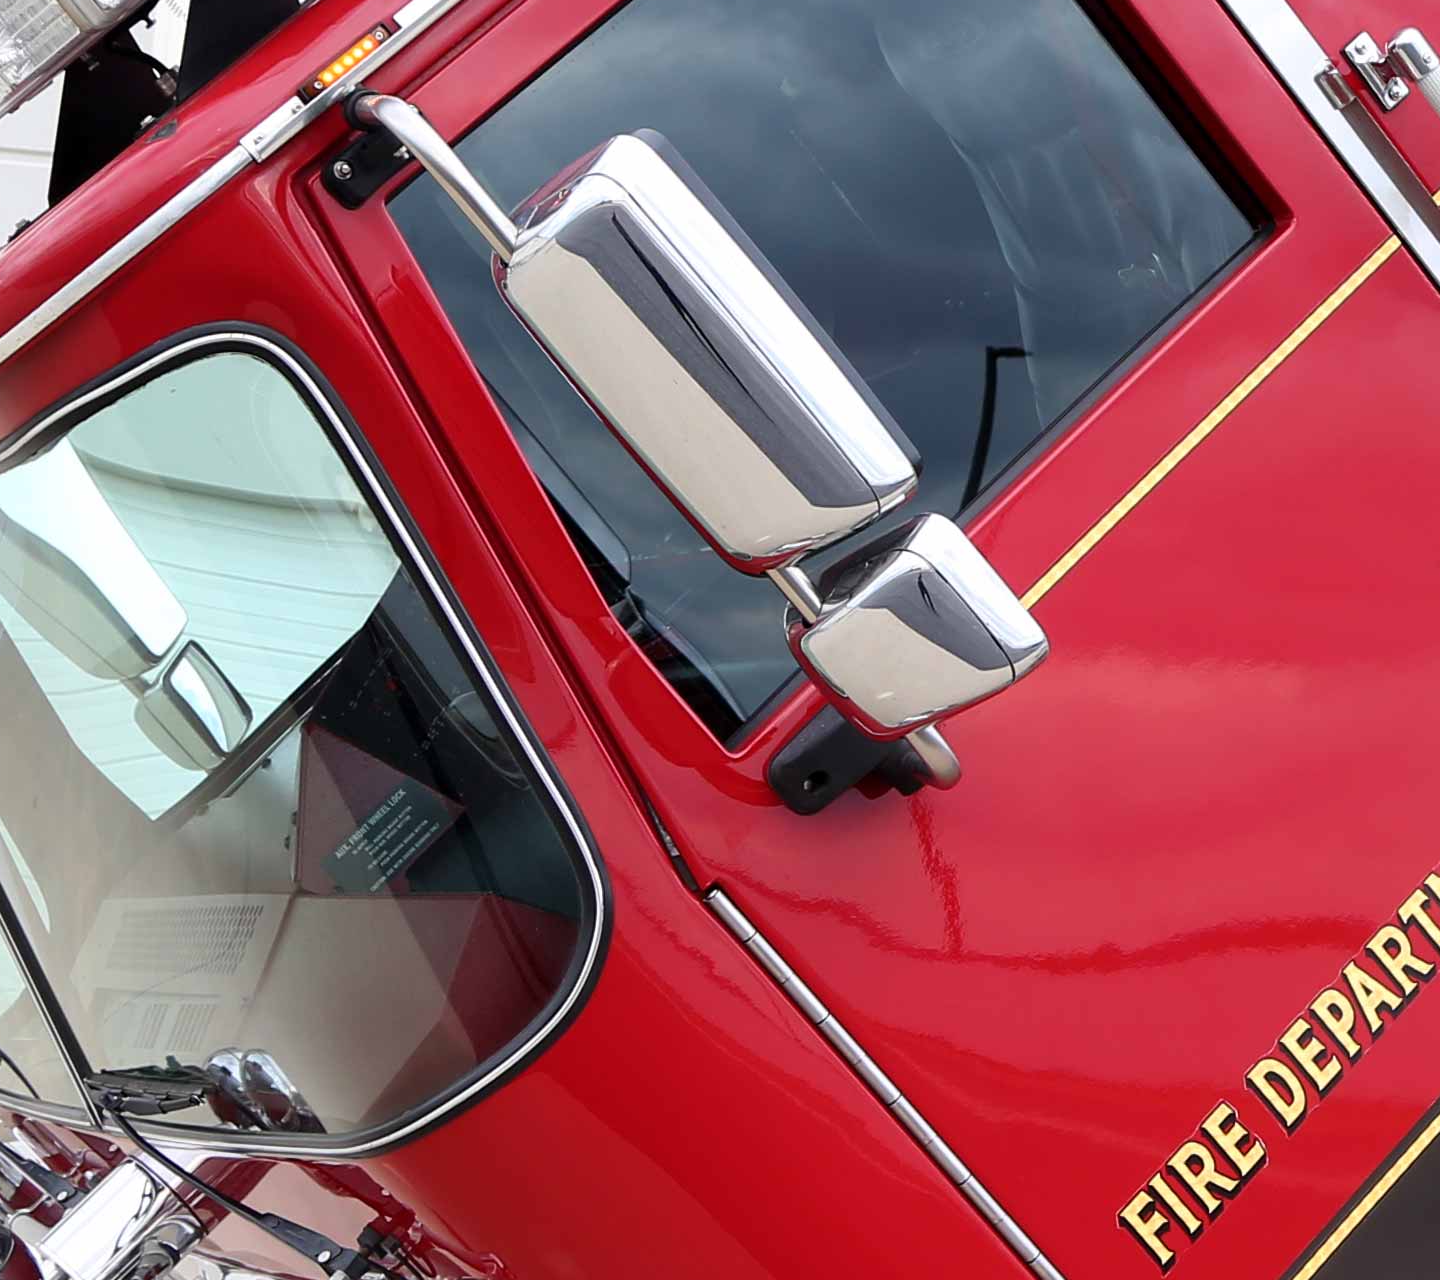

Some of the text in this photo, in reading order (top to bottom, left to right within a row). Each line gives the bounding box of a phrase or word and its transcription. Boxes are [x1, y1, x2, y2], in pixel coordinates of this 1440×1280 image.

[348, 823, 370, 846] FRONT
[367, 805, 391, 827] WHEEL
[387, 788, 407, 807] LOCK
[1117, 1101, 1267, 1276] FIRE
